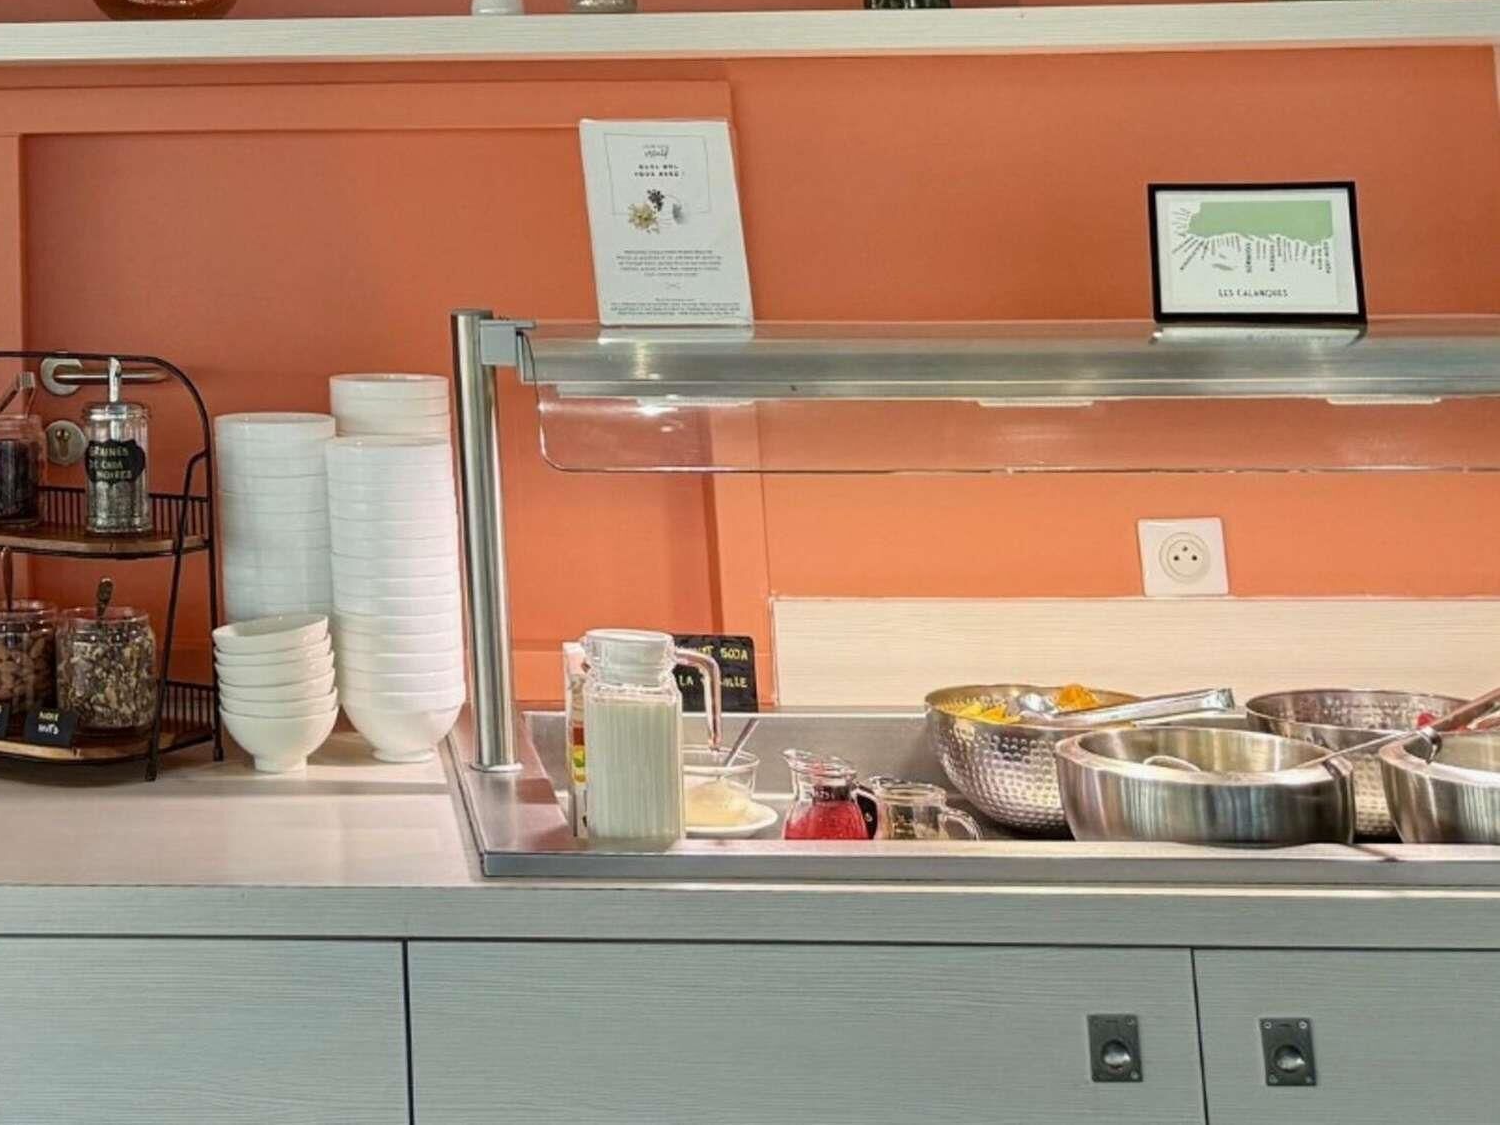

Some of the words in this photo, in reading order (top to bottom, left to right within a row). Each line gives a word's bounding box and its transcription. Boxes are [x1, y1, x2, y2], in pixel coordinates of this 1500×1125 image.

[1218, 288, 1234, 298] LES
[1236, 288, 1289, 299] CALANQUES
[679, 675, 694, 687] LA
